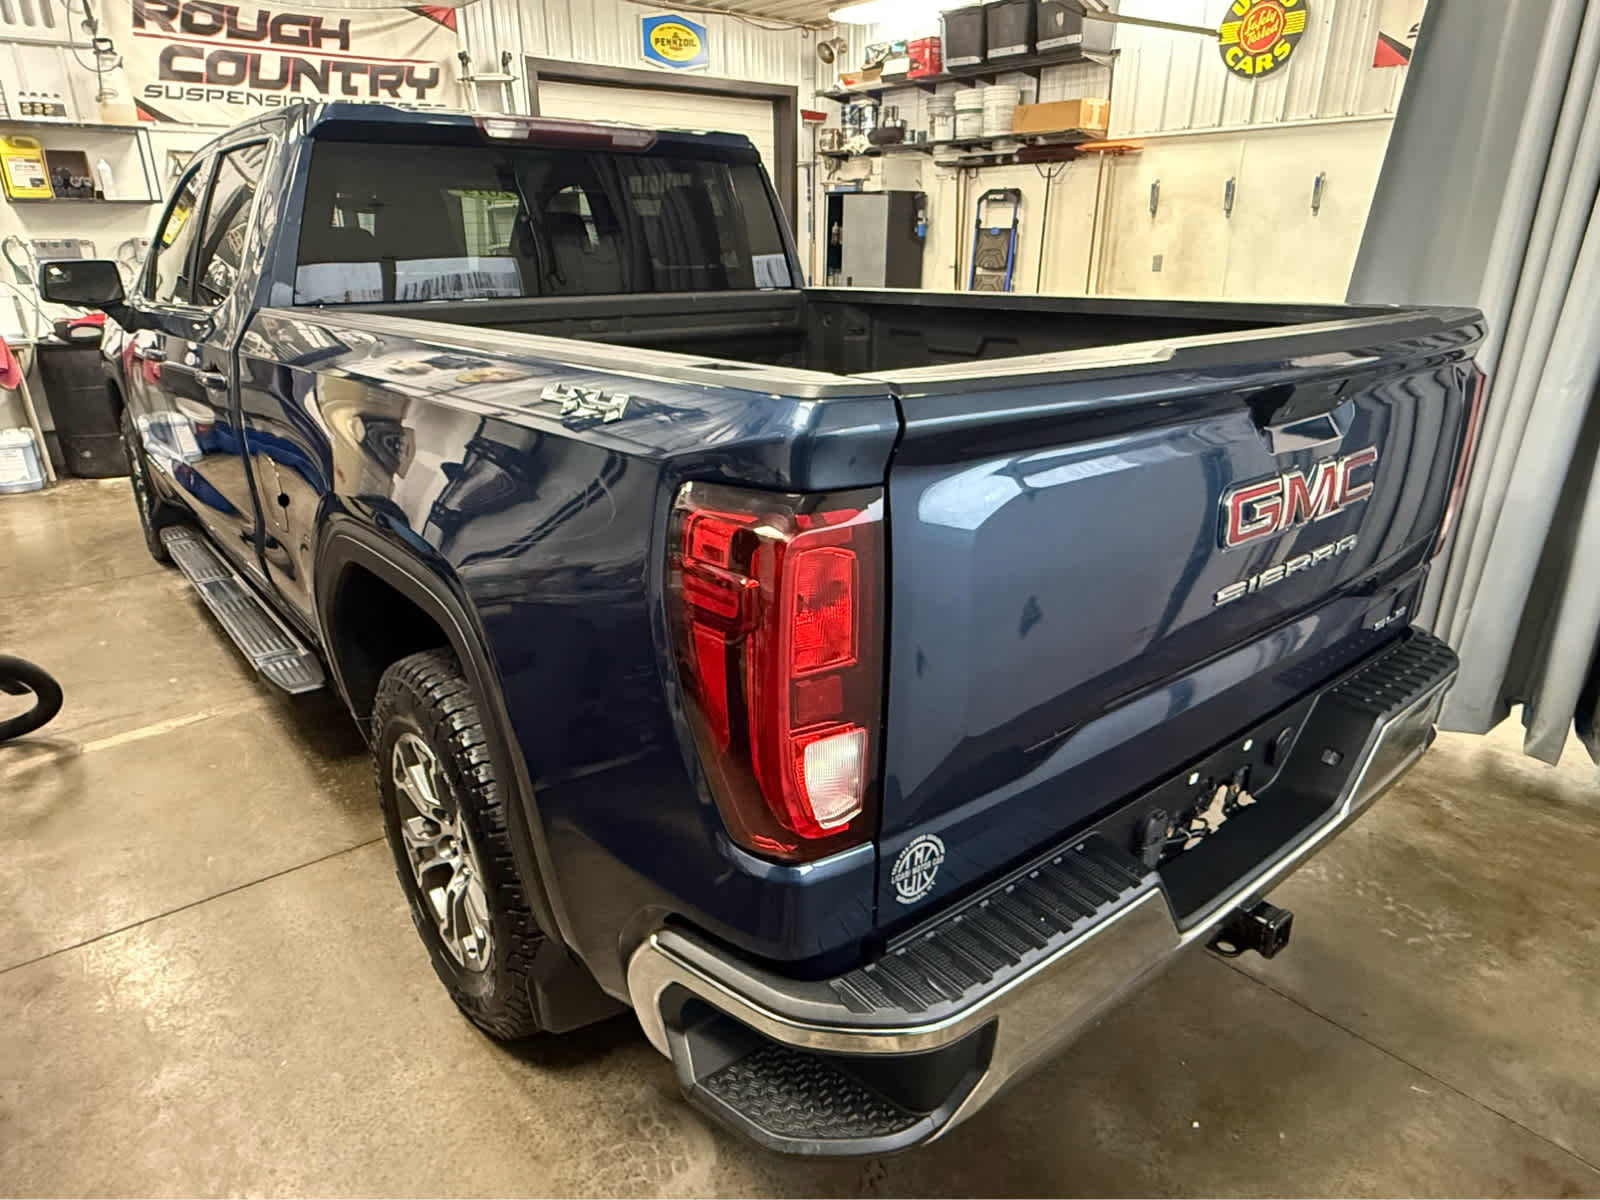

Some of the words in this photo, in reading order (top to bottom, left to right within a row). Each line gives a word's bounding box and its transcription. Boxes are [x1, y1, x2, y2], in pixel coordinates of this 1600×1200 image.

[131, 0, 351, 51] ROUGH
[654, 37, 697, 47] PENNZOIL
[159, 44, 440, 99] COUNTRY
[1225, 39, 1291, 74] CARS
[1224, 445, 1378, 548] GMC
[1213, 534, 1358, 606] SIERRA
